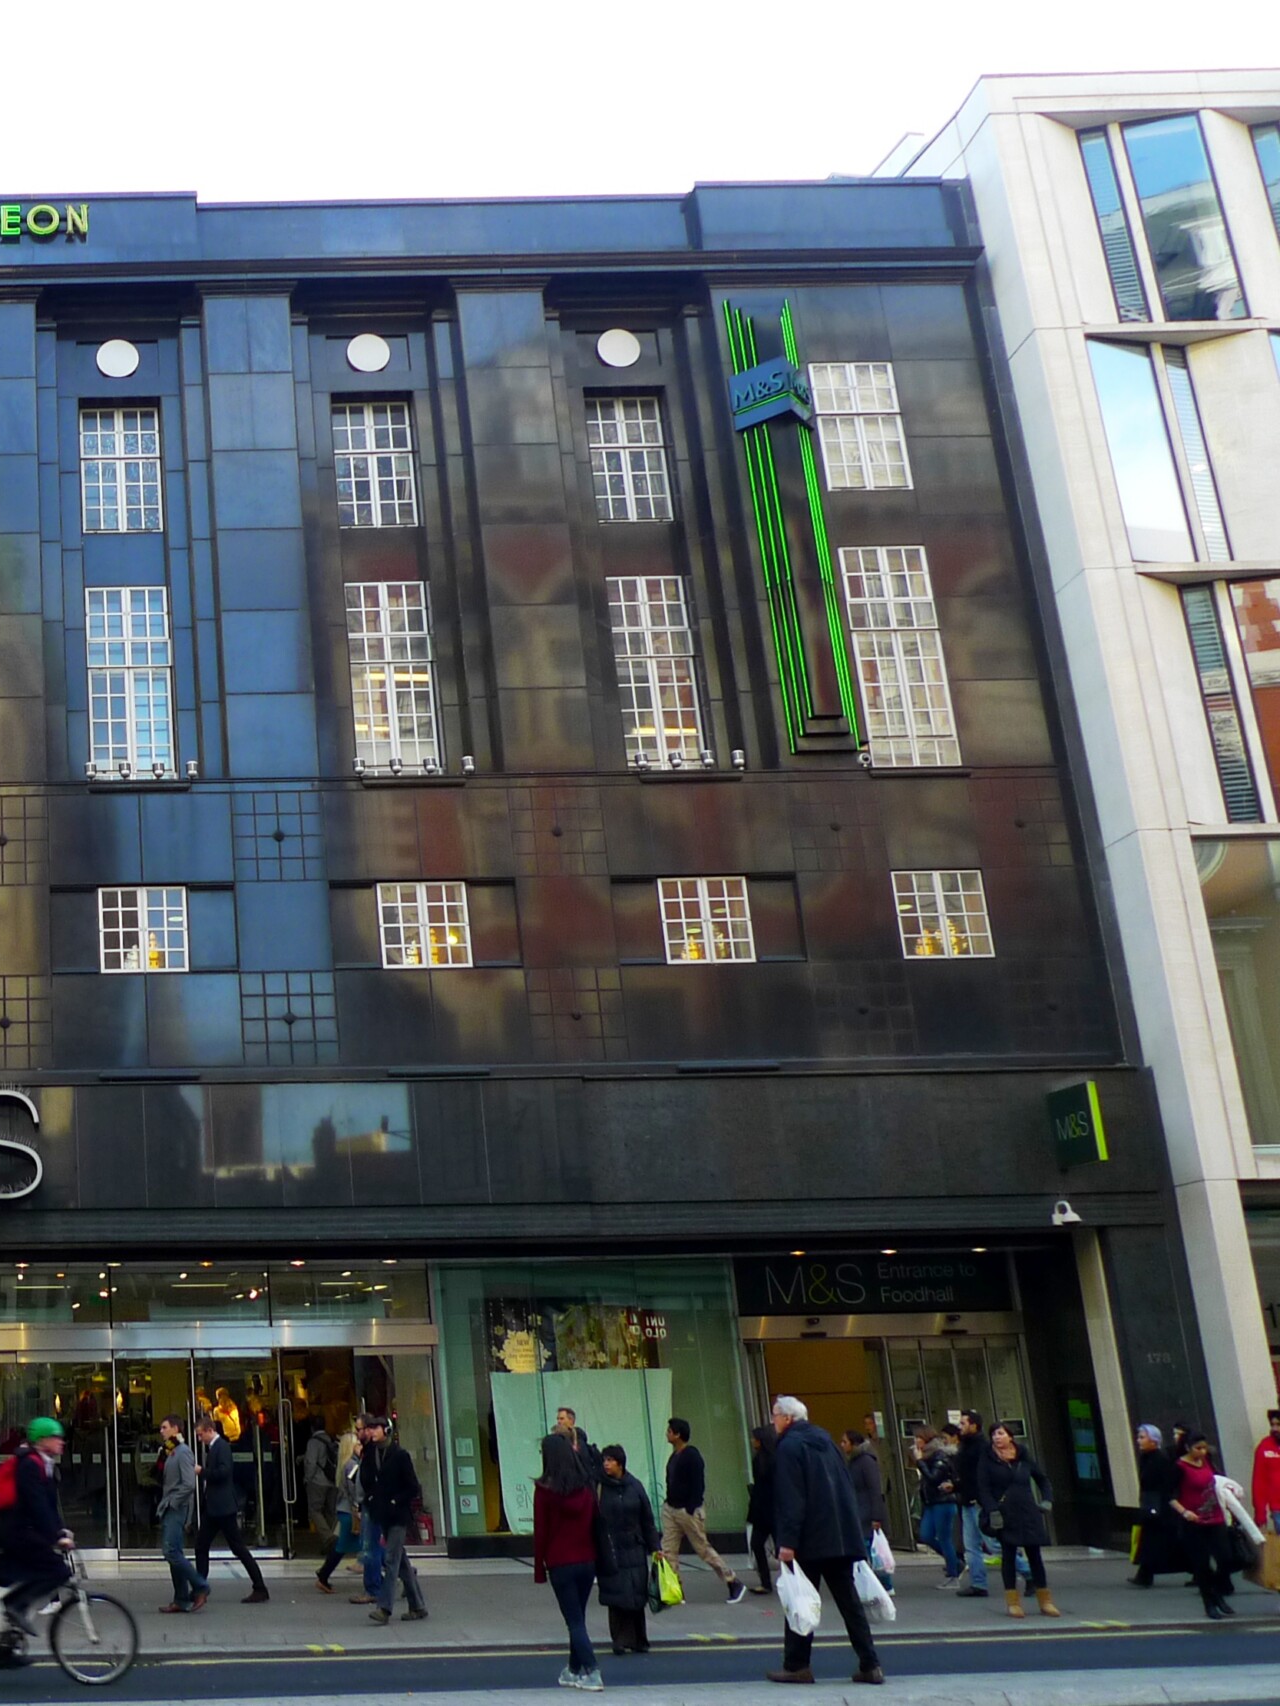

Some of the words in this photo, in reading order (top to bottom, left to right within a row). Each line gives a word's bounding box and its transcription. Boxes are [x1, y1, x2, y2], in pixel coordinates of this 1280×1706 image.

[734, 371, 785, 408] M&S
[1055, 1110, 1089, 1142] M&S
[765, 1263, 866, 1305] M&S
[877, 1262, 954, 1279] Entrance
[959, 1263, 977, 1278] to
[880, 1285, 954, 1303] Foodhall
